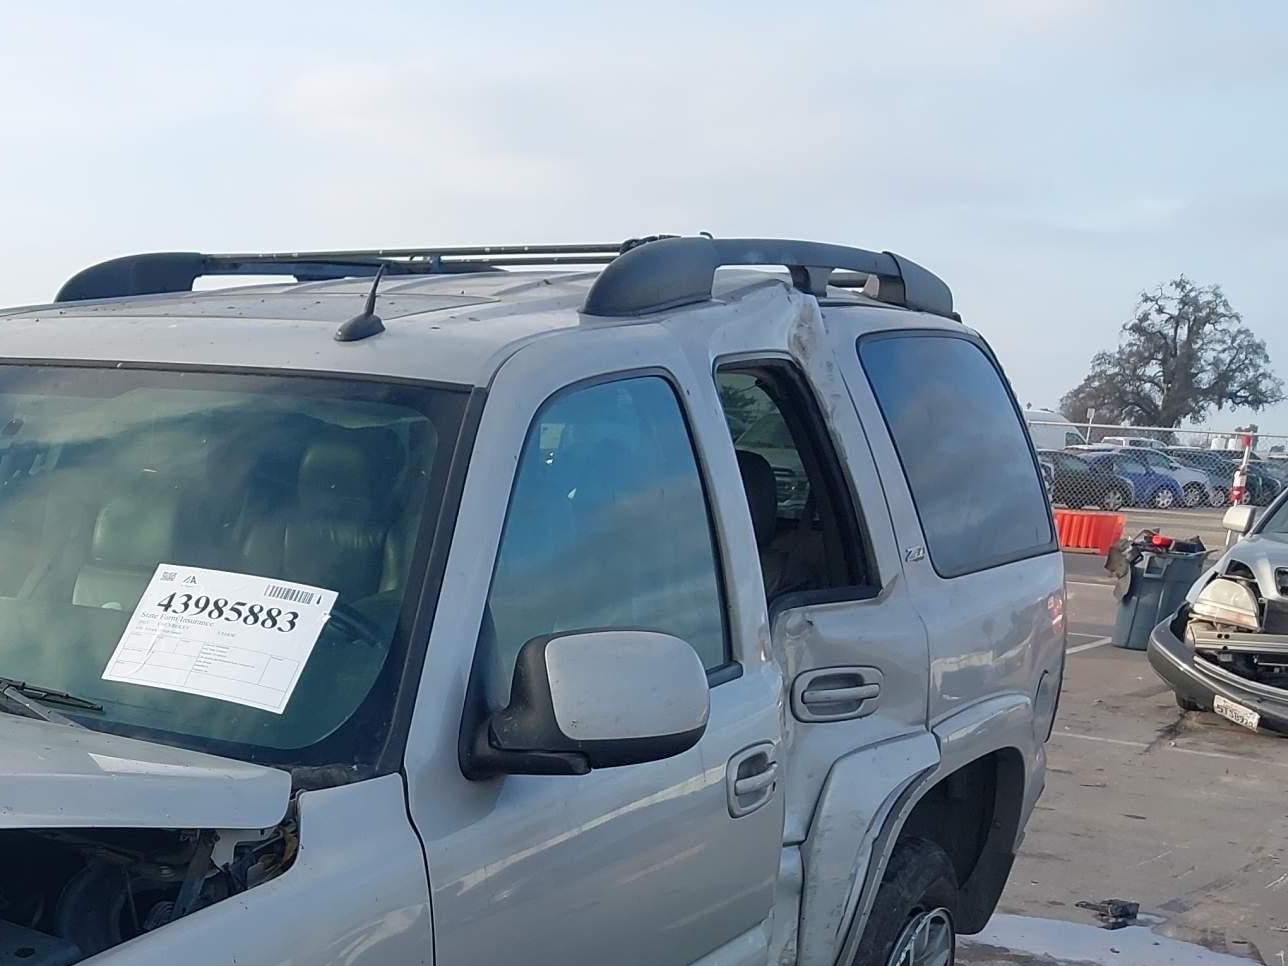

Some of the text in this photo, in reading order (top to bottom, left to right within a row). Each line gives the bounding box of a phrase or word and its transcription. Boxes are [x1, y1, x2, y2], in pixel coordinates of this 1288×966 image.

[157, 592, 300, 632] 43985883
[159, 613, 178, 621] Farm
[179, 615, 215, 627] Insurance
